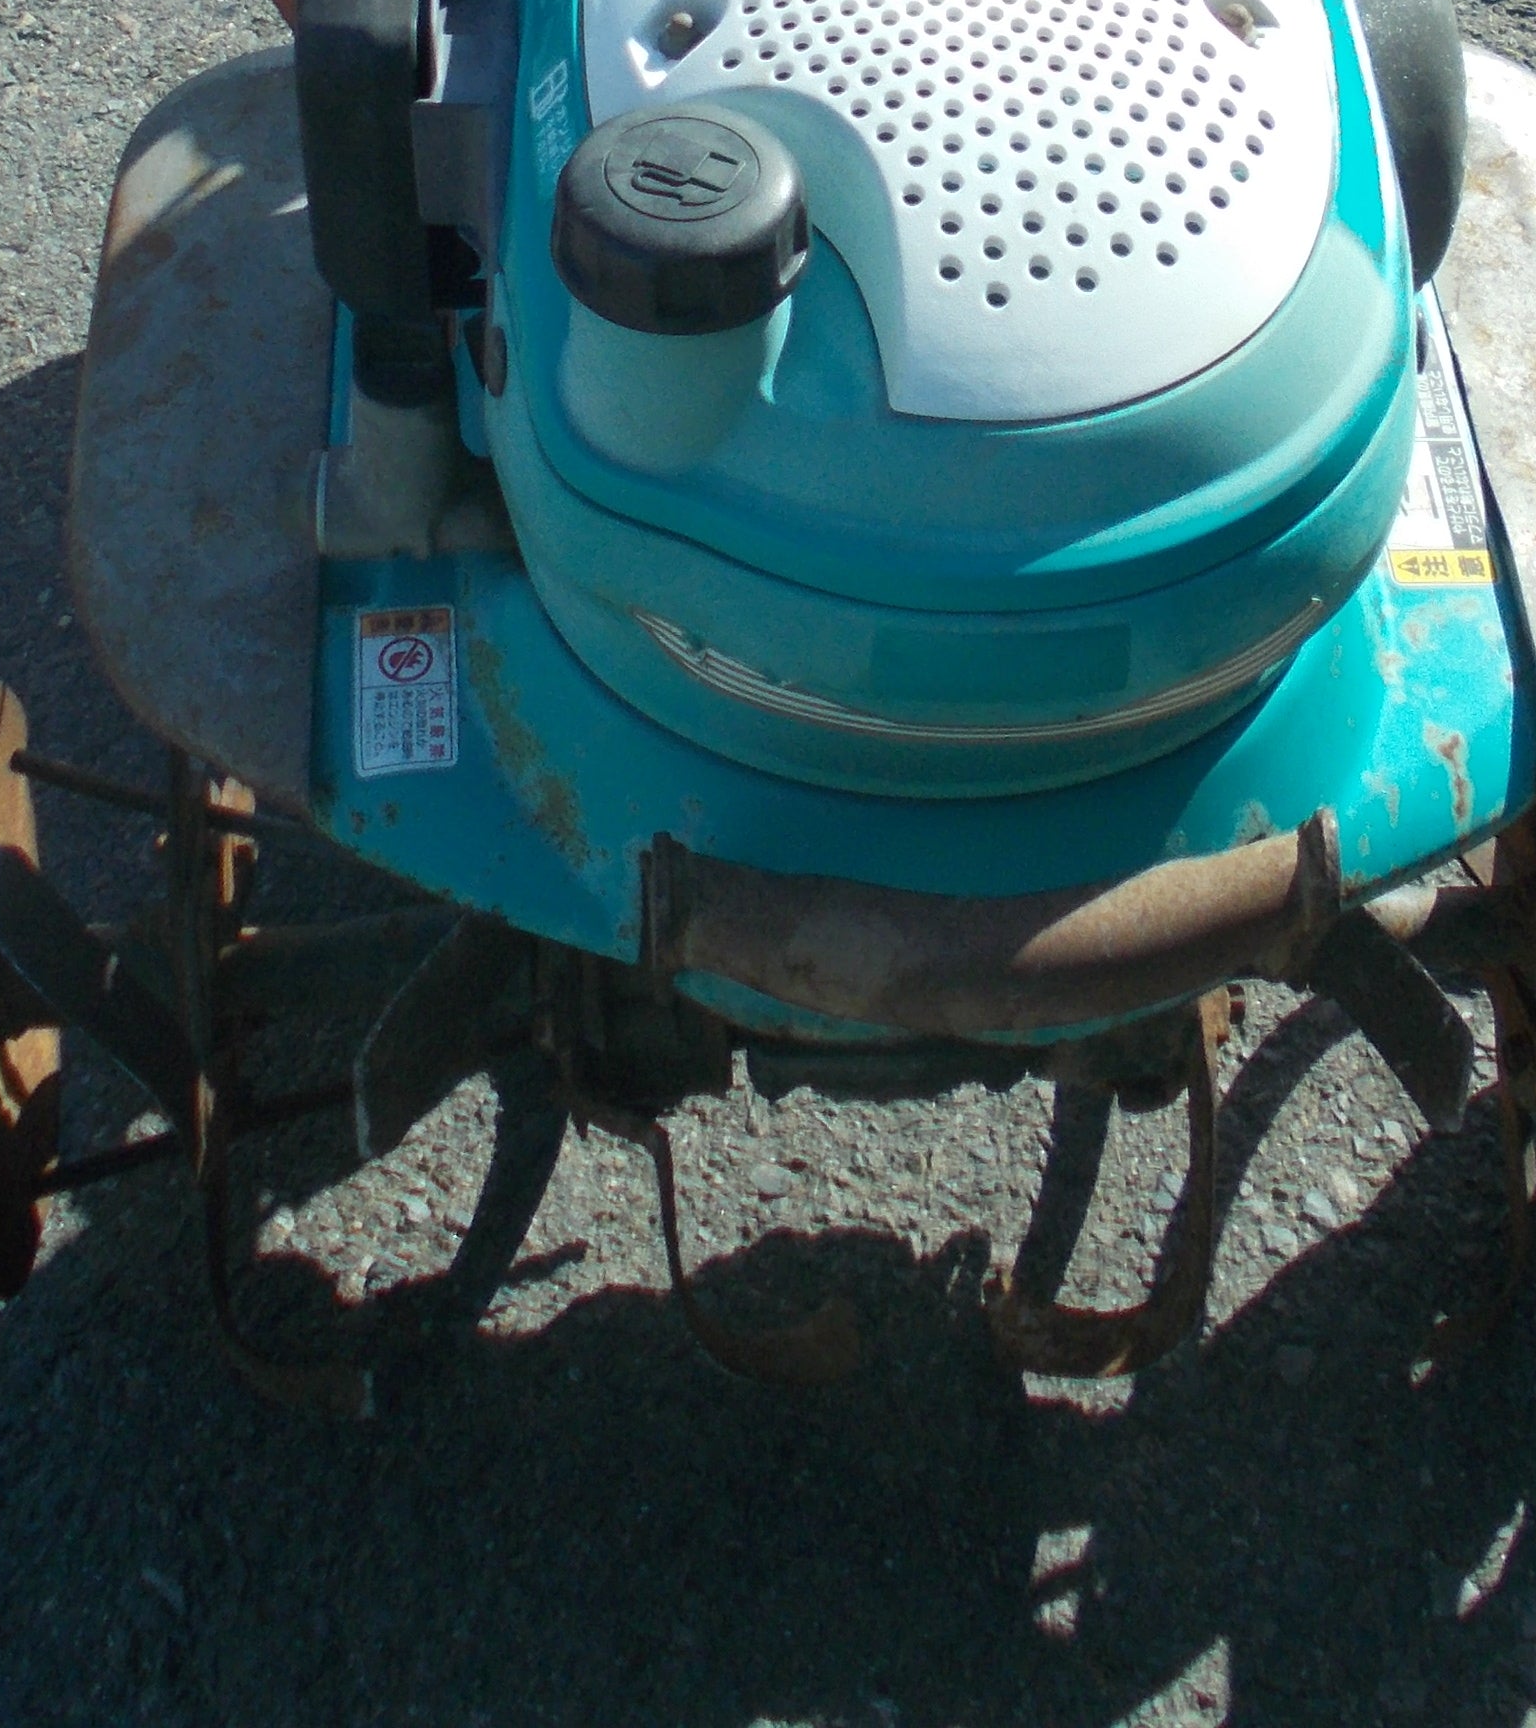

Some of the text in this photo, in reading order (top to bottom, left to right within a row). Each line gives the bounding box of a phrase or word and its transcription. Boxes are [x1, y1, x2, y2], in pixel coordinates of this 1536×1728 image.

[1435, 455, 1468, 534] やけどをするので
[1421, 554, 1486, 578] 注意
